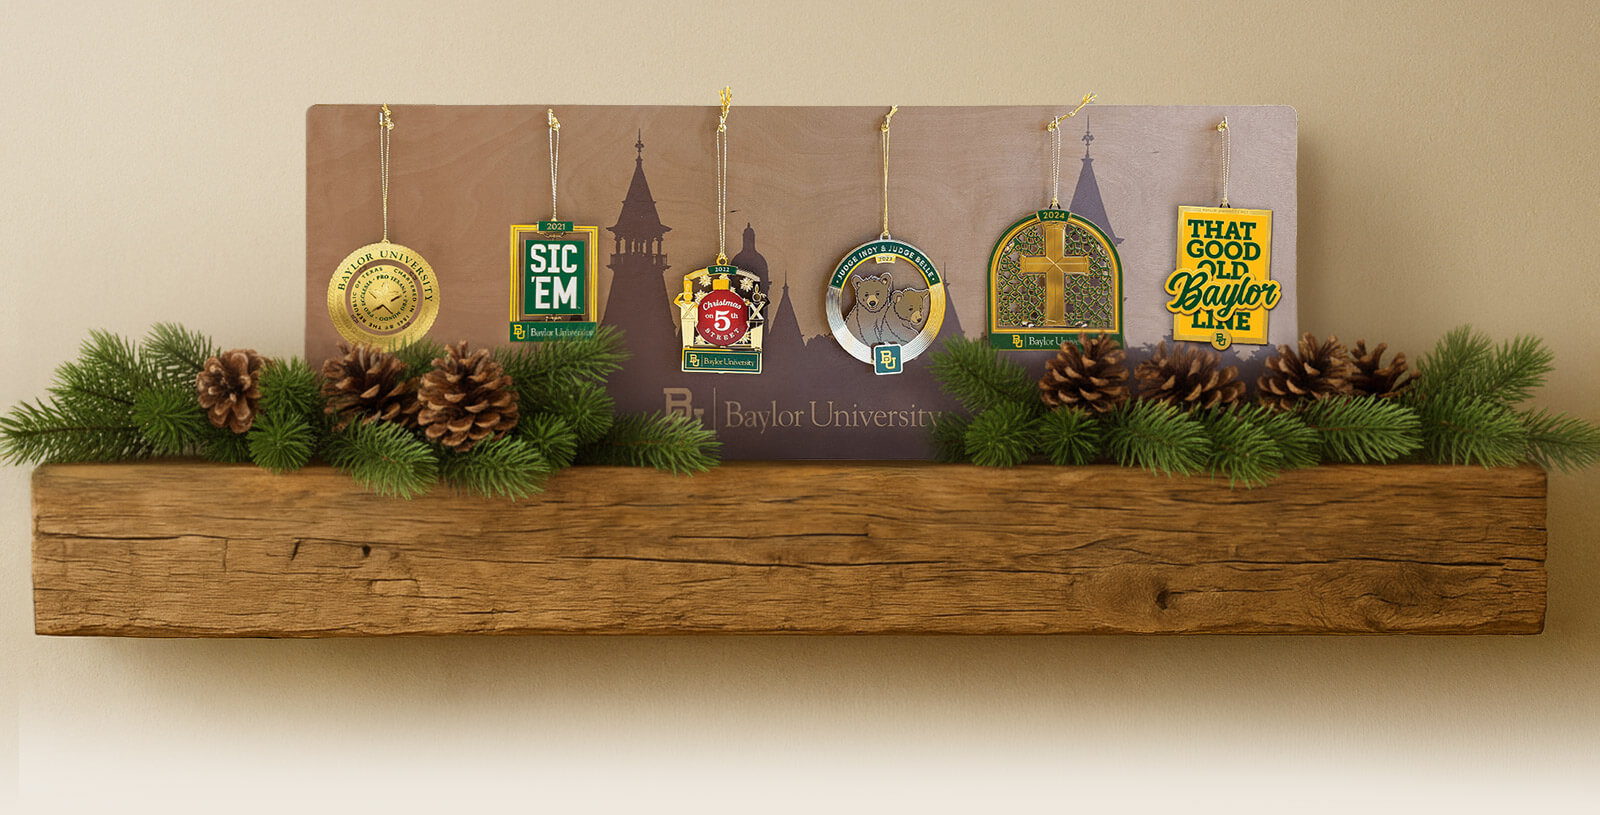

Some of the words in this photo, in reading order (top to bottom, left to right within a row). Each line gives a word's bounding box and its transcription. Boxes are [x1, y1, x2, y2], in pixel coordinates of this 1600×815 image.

[546, 222, 566, 230] 2021
[1188, 219, 1256, 240] THAT
[530, 244, 577, 273] SIC
[1186, 239, 1261, 261] GOOD
[362, 267, 383, 278] TEXAS
[838, 256, 858, 280] JUDGE
[858, 246, 878, 258] INDY
[888, 246, 917, 259] JUDGE
[915, 256, 934, 278] BELLE
[1197, 260, 1249, 280] OLD
[338, 253, 373, 290] BAYLOR
[380, 251, 433, 302] UNIVERSITY
[531, 276, 577, 309] 'EM
[1168, 271, 1278, 318] Baylor
[352, 292, 366, 323] REPUBLIC
[702, 299, 742, 311] Christmas
[369, 322, 381, 330] THE
[1191, 310, 1251, 331] LINE
[513, 324, 525, 339] BU
[705, 328, 739, 340] STREET
[1012, 335, 1023, 348] BU
[1029, 336, 1054, 347] Baylor
[1216, 333, 1226, 346] BU
[704, 357, 723, 367] Baylor
[724, 357, 754, 367] University
[881, 350, 896, 369] BU
[724, 400, 804, 434] Baylor
[809, 400, 942, 433] University
